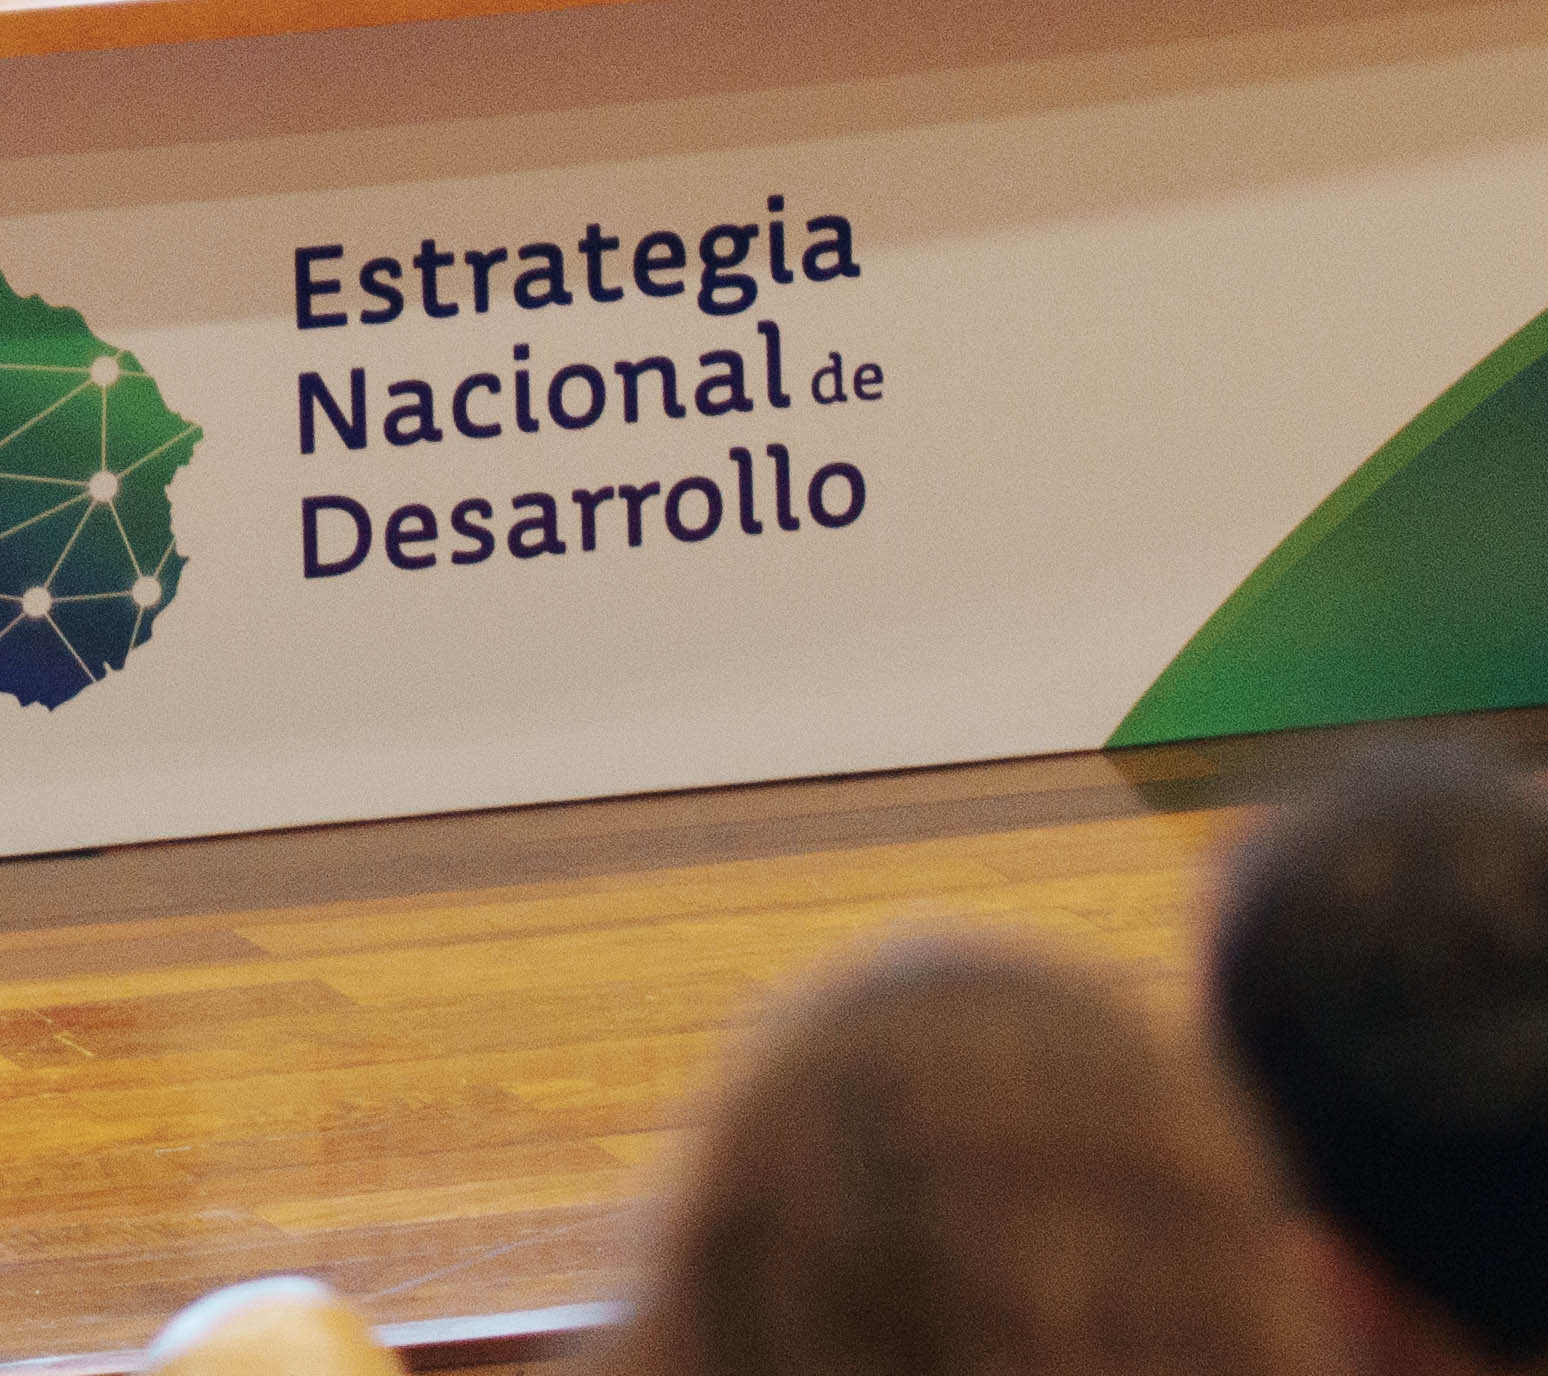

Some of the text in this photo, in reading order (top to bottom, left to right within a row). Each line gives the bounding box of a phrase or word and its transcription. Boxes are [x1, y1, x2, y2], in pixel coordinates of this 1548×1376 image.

[295, 195, 861, 329] Estrategia
[298, 320, 885, 454] Nacional de
[302, 443, 867, 580] Desarrollo
